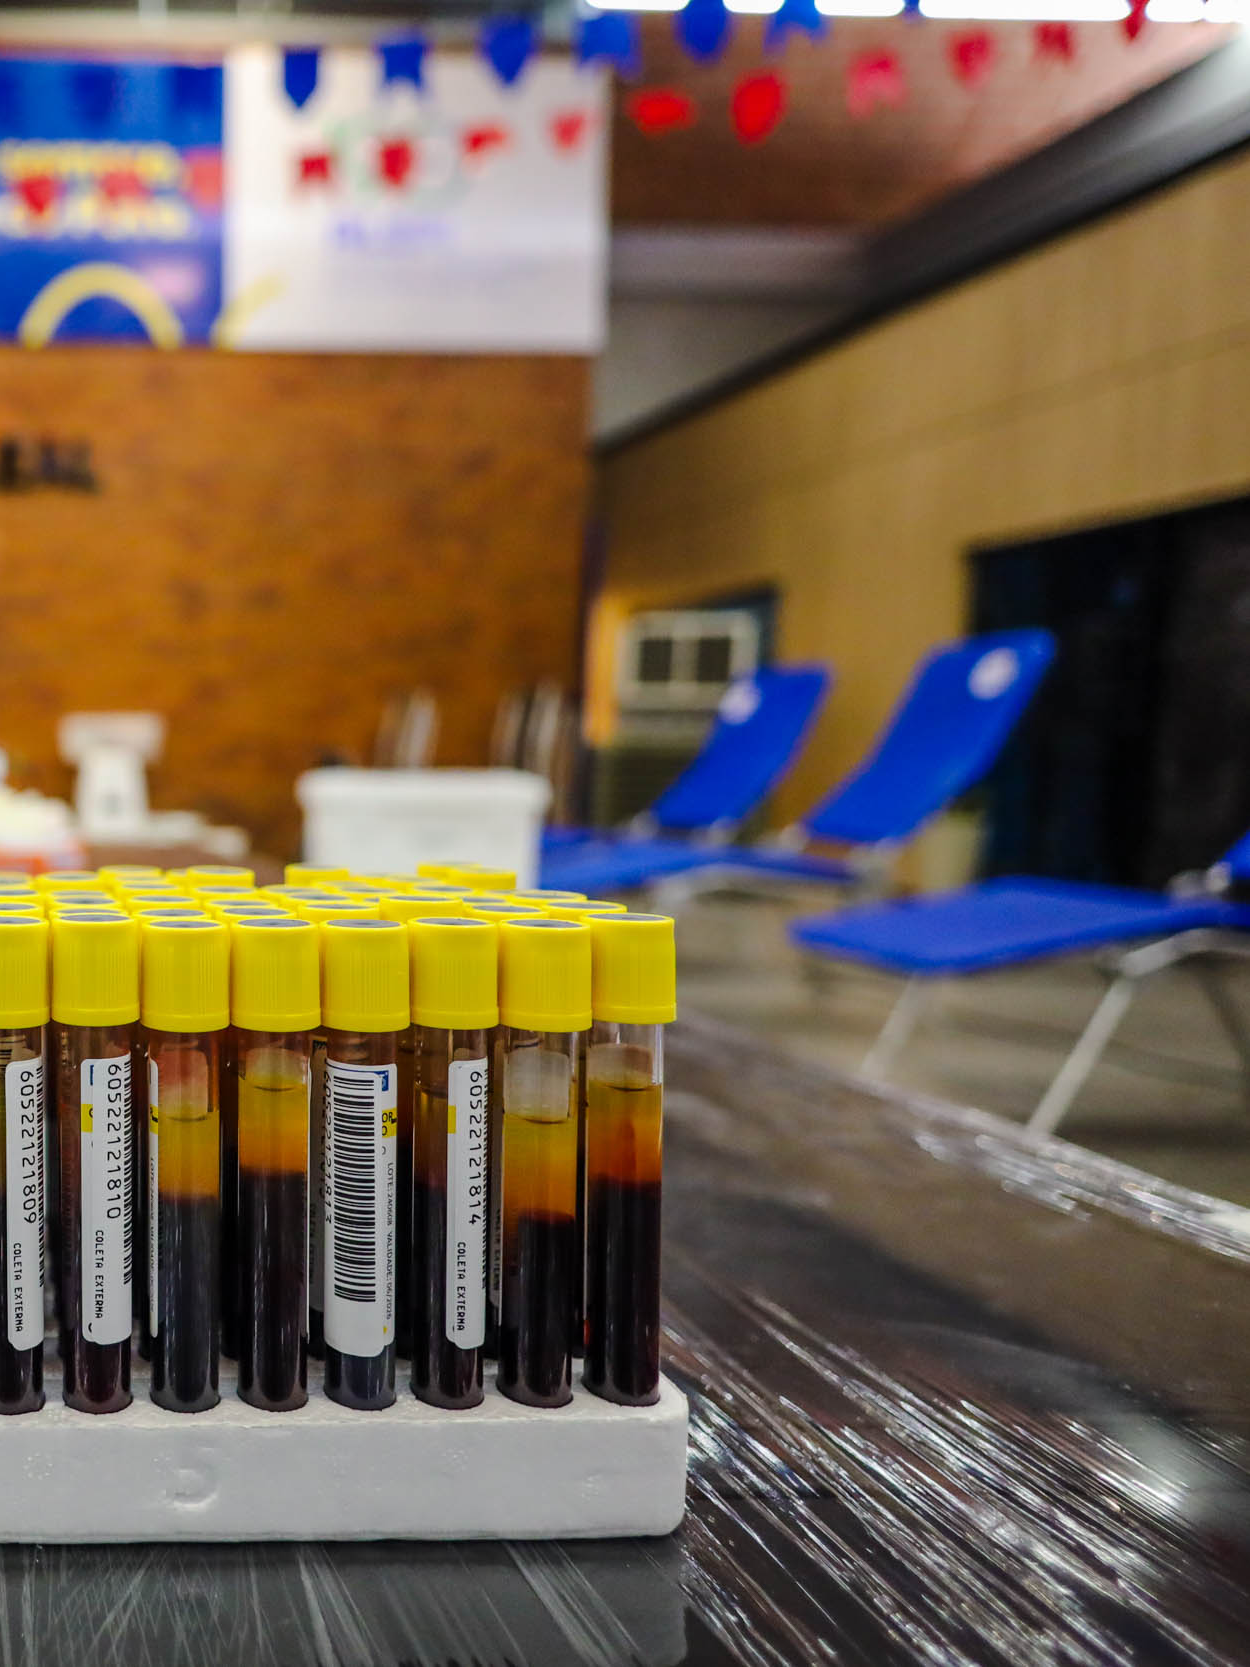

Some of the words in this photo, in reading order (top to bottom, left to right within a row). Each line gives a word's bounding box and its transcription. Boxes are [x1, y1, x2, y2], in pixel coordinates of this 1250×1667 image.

[20, 1070, 37, 1224] 60522121809
[107, 1064, 122, 1220] 60522121810
[469, 1071, 483, 1224] 60522121814
[13, 1242, 22, 1281] COLETA
[95, 1230, 104, 1269] COLETA
[457, 1242, 466, 1280] COLETA
[14, 1287, 23, 1332] EXTERNA
[95, 1275, 104, 1319] EXTERNA
[456, 1286, 466, 1332] EXTERNA
